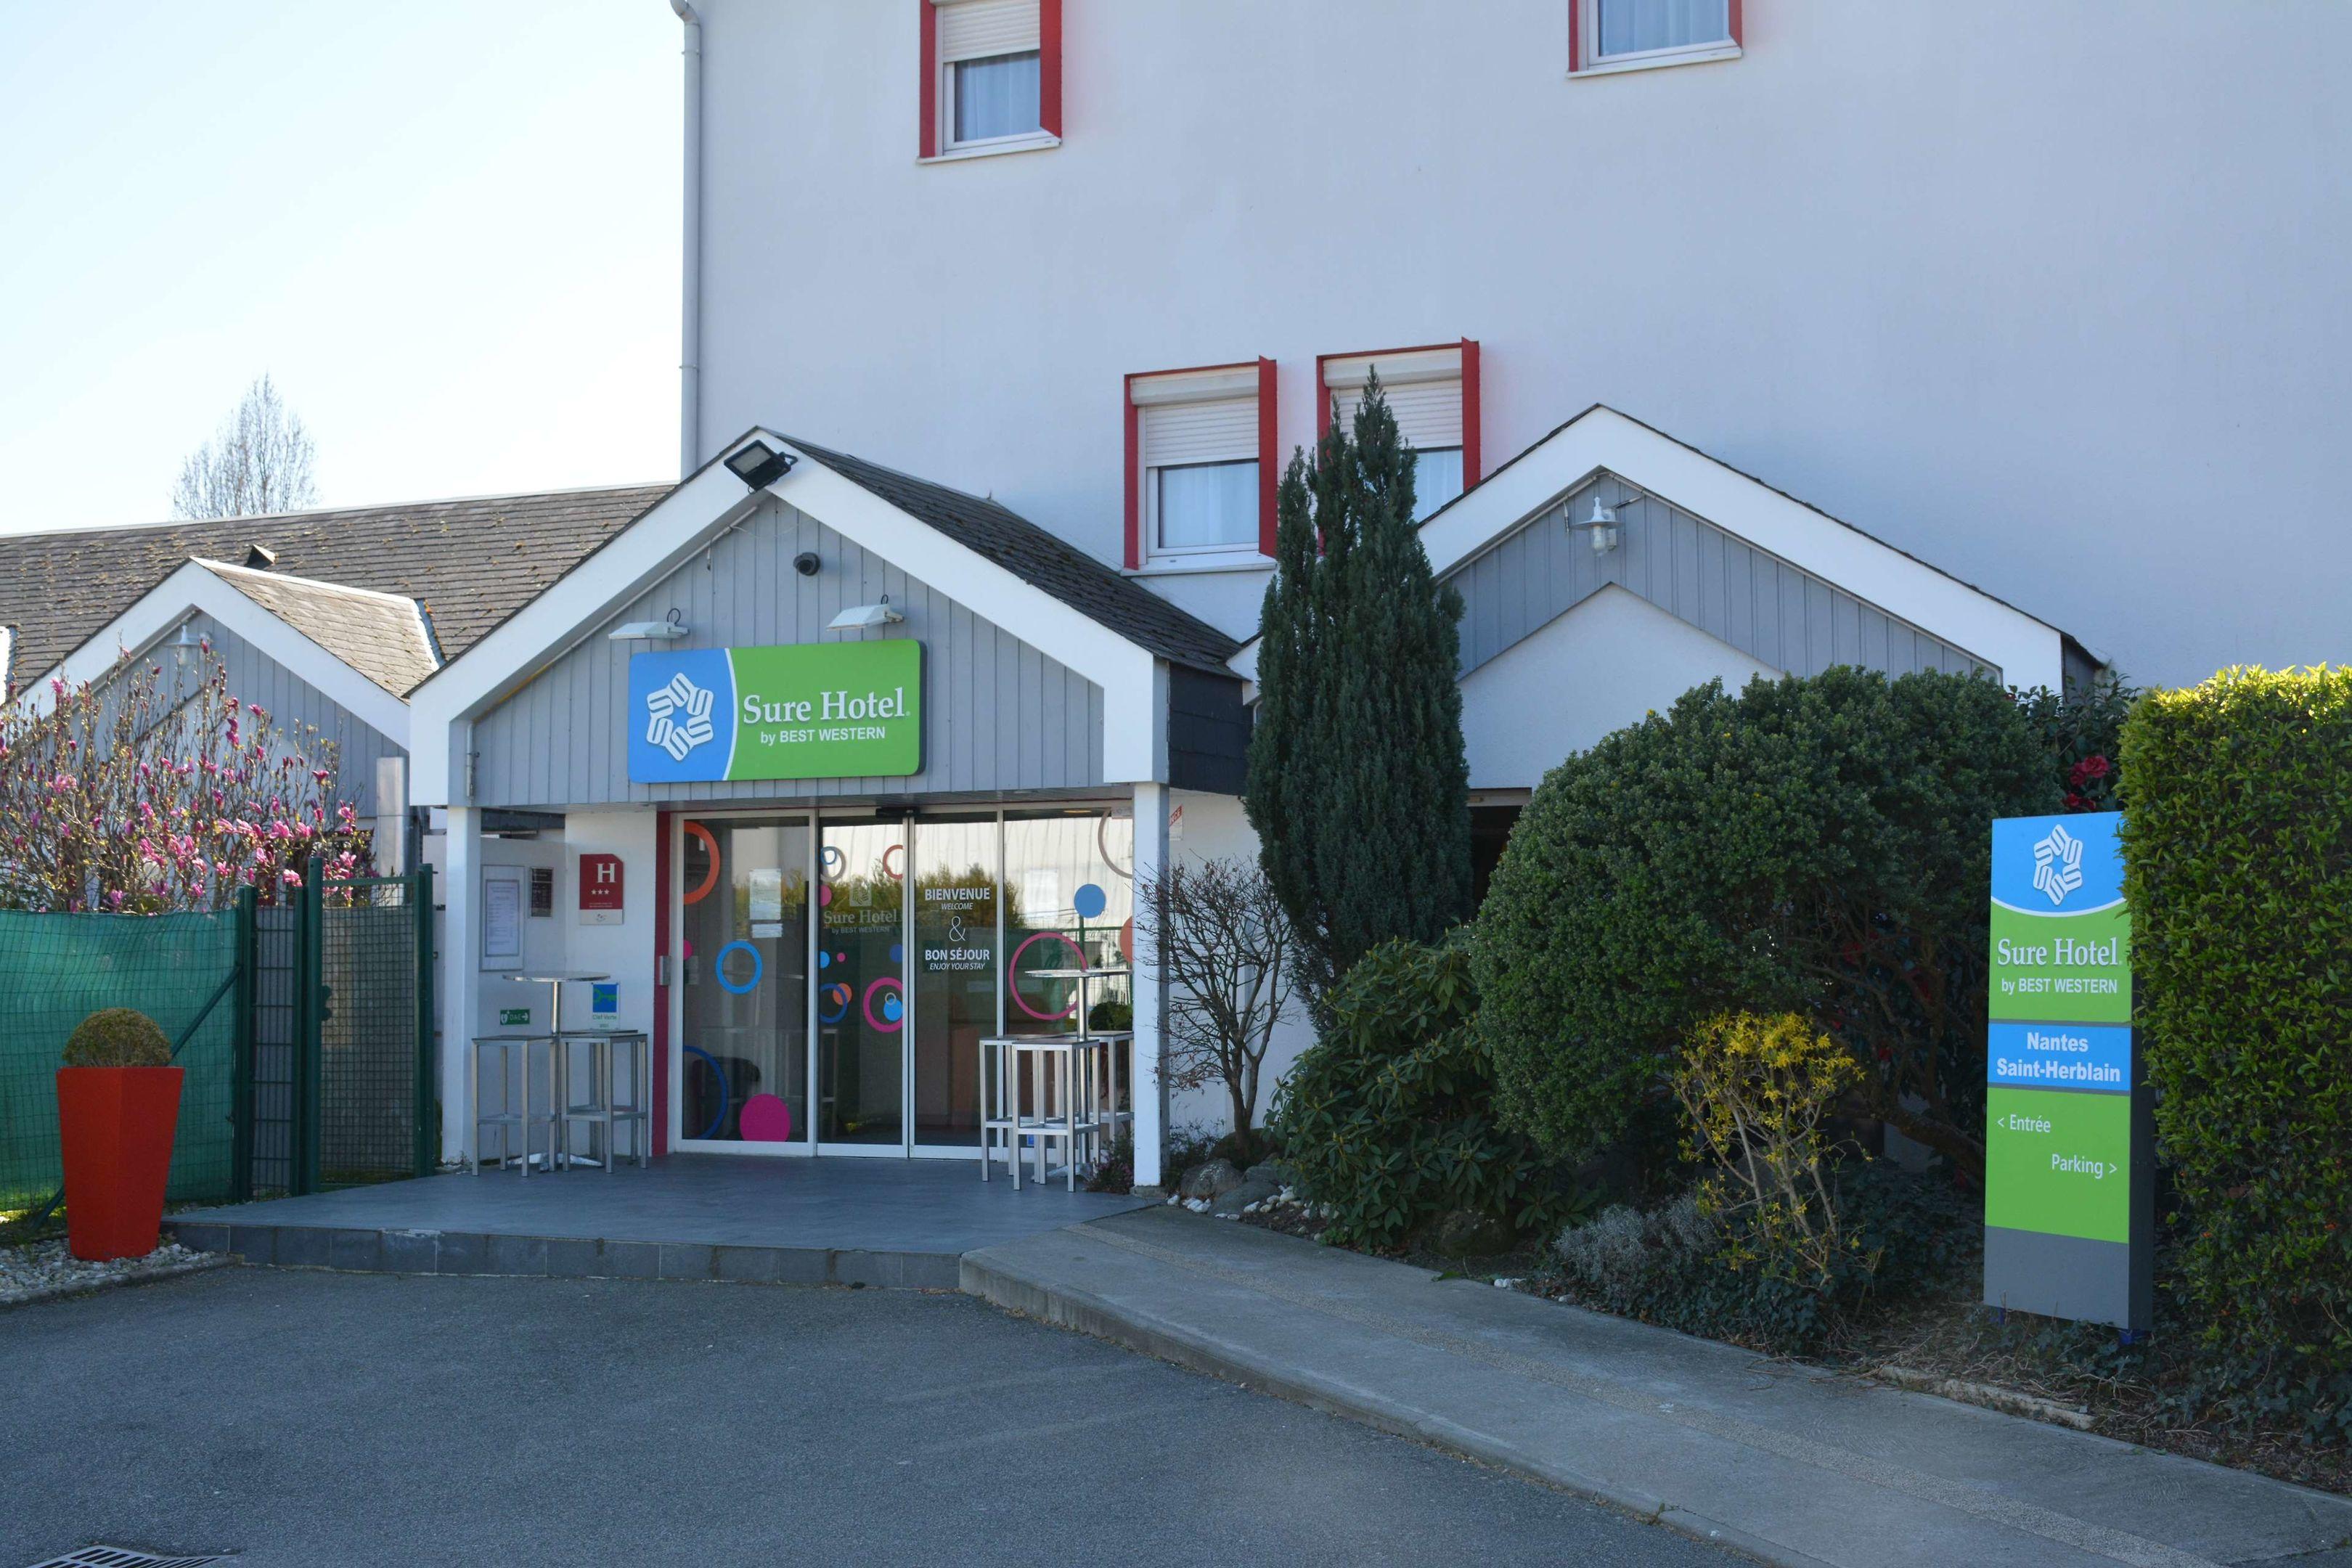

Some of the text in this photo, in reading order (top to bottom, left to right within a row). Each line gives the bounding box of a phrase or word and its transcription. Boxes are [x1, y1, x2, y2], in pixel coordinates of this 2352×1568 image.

[743, 687, 905, 724] Sure Hotel
[760, 727, 886, 746] by BEST WESTERN
[597, 862, 616, 883] H
[925, 888, 990, 901] BIENVENUE
[823, 910, 898, 924] Sure Hotel
[949, 915, 966, 942] &
[925, 947, 990, 961] BON SÉJOUR
[1998, 936, 2118, 966] Sure Hotel
[2001, 978, 2118, 995] by BEST WESTERN
[2027, 1032, 2088, 1053] Nantes
[1996, 1058, 2120, 1082] Saint-Herblain
[2009, 1114, 2051, 1133] Entrée
[2051, 1153, 2104, 1180] Parking
